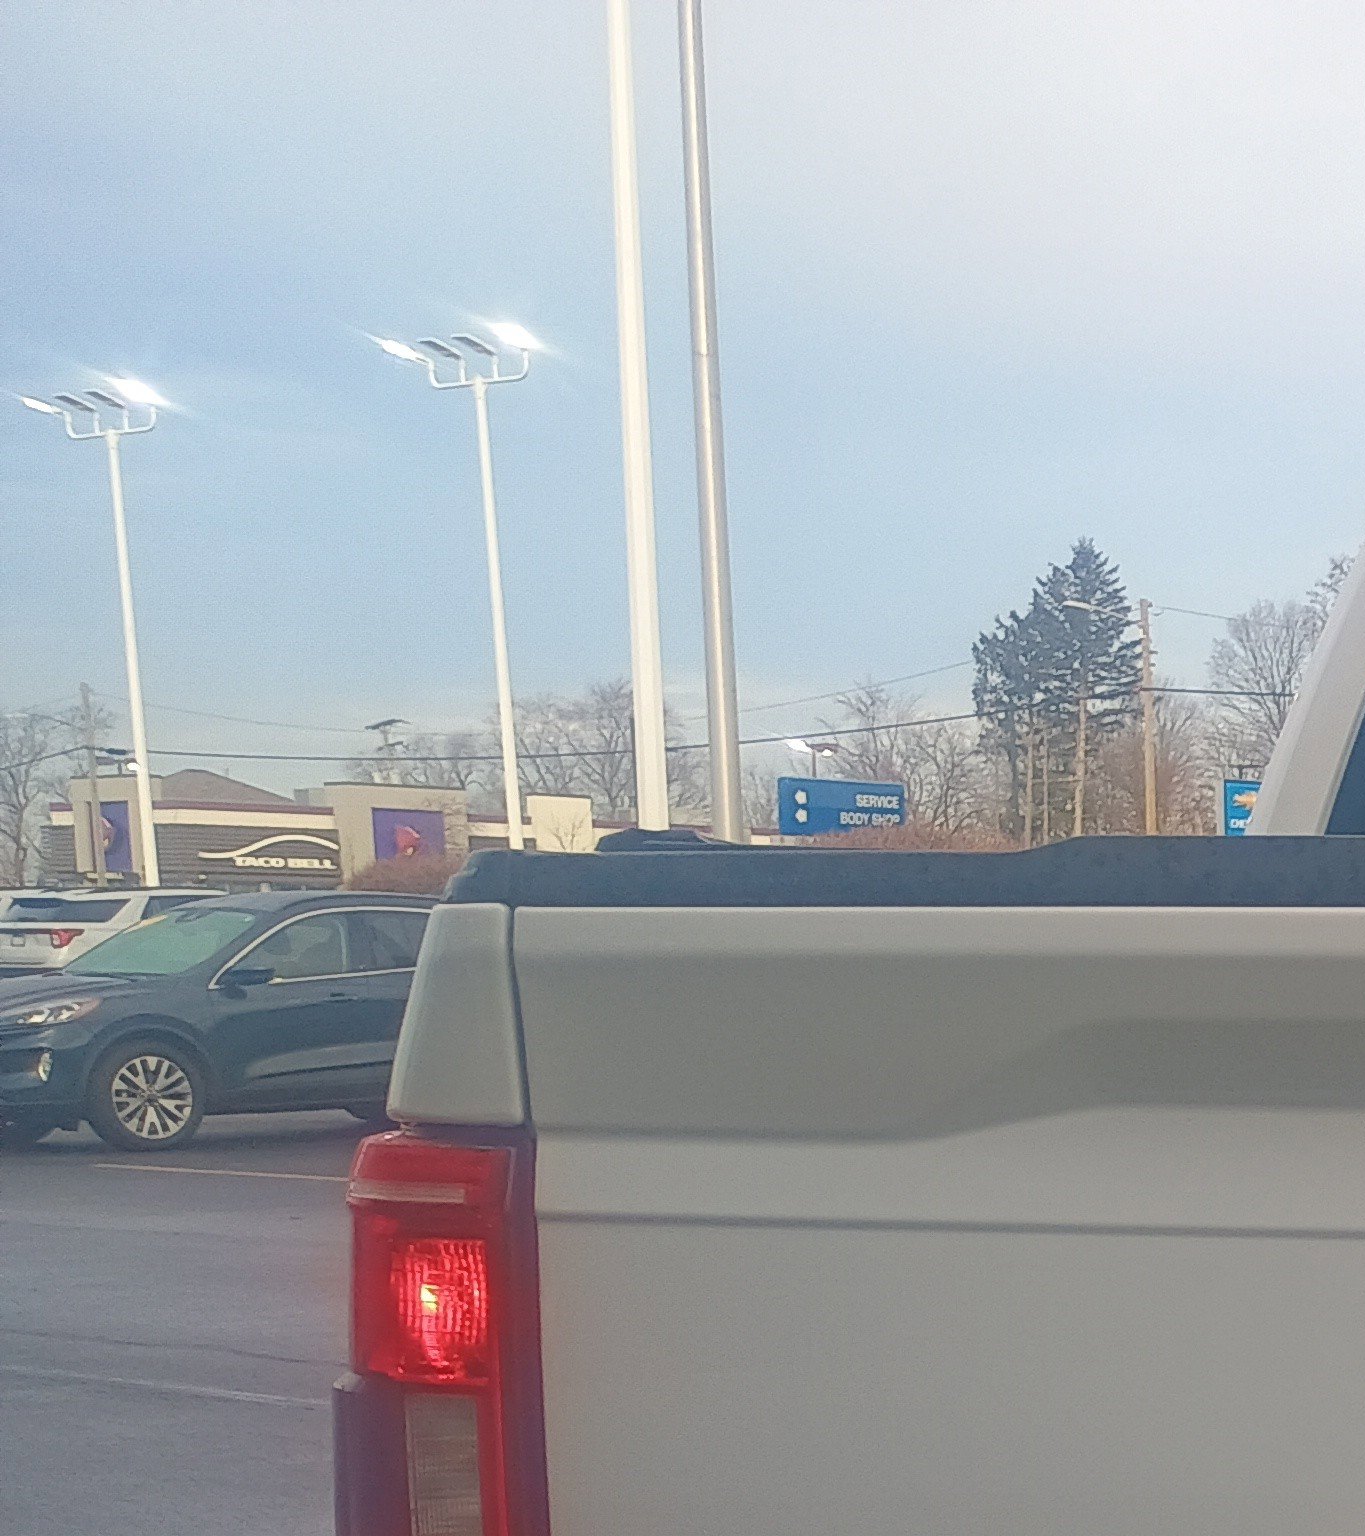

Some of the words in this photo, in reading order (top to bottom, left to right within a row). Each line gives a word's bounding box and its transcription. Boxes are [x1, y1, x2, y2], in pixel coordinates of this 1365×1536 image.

[855, 793, 900, 809] SERVICE
[840, 811, 871, 825] BODY
[872, 813, 901, 826] SHOP
[233, 856, 285, 868] TACO
[287, 858, 337, 870] BELL
